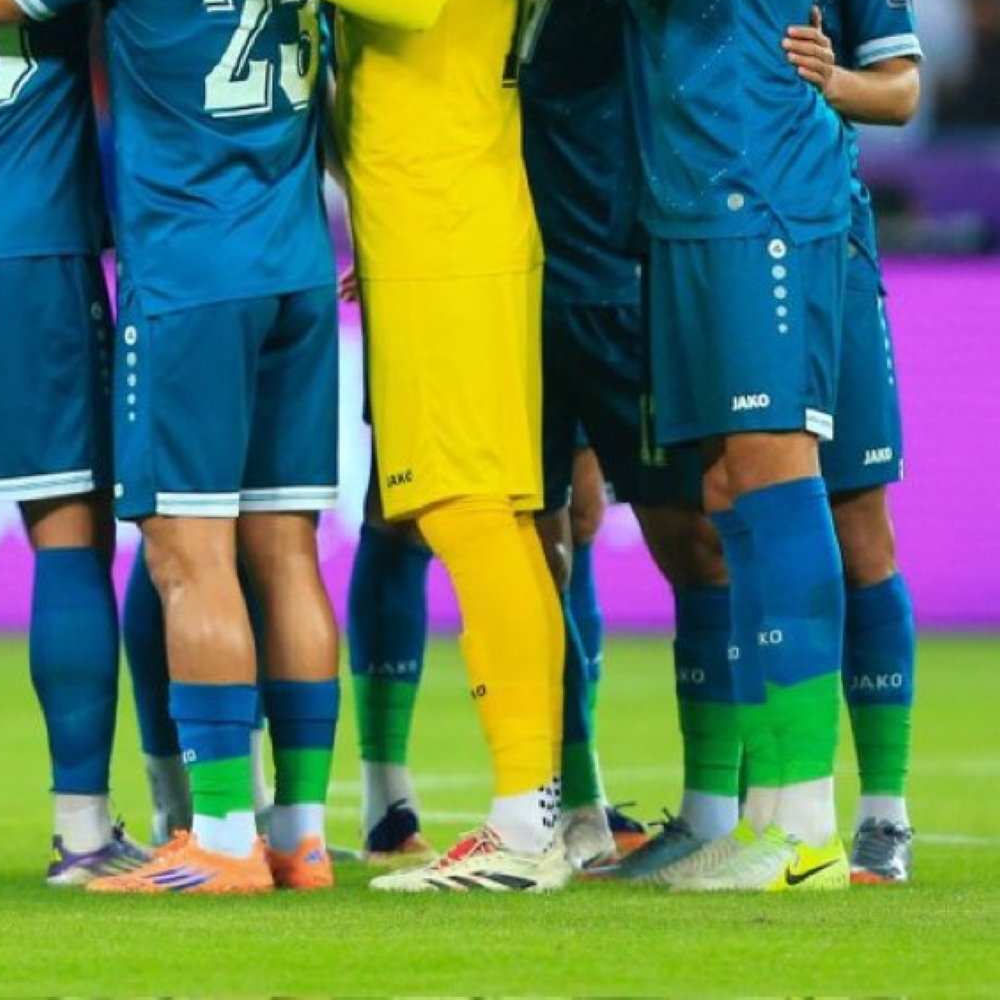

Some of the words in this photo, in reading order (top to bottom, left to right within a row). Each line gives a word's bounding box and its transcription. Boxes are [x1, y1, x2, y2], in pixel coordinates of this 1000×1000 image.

[732, 393, 771, 411] JAKO
[864, 447, 893, 466] JAKO
[758, 629, 783, 645] KO
[850, 672, 902, 691] JAKO
